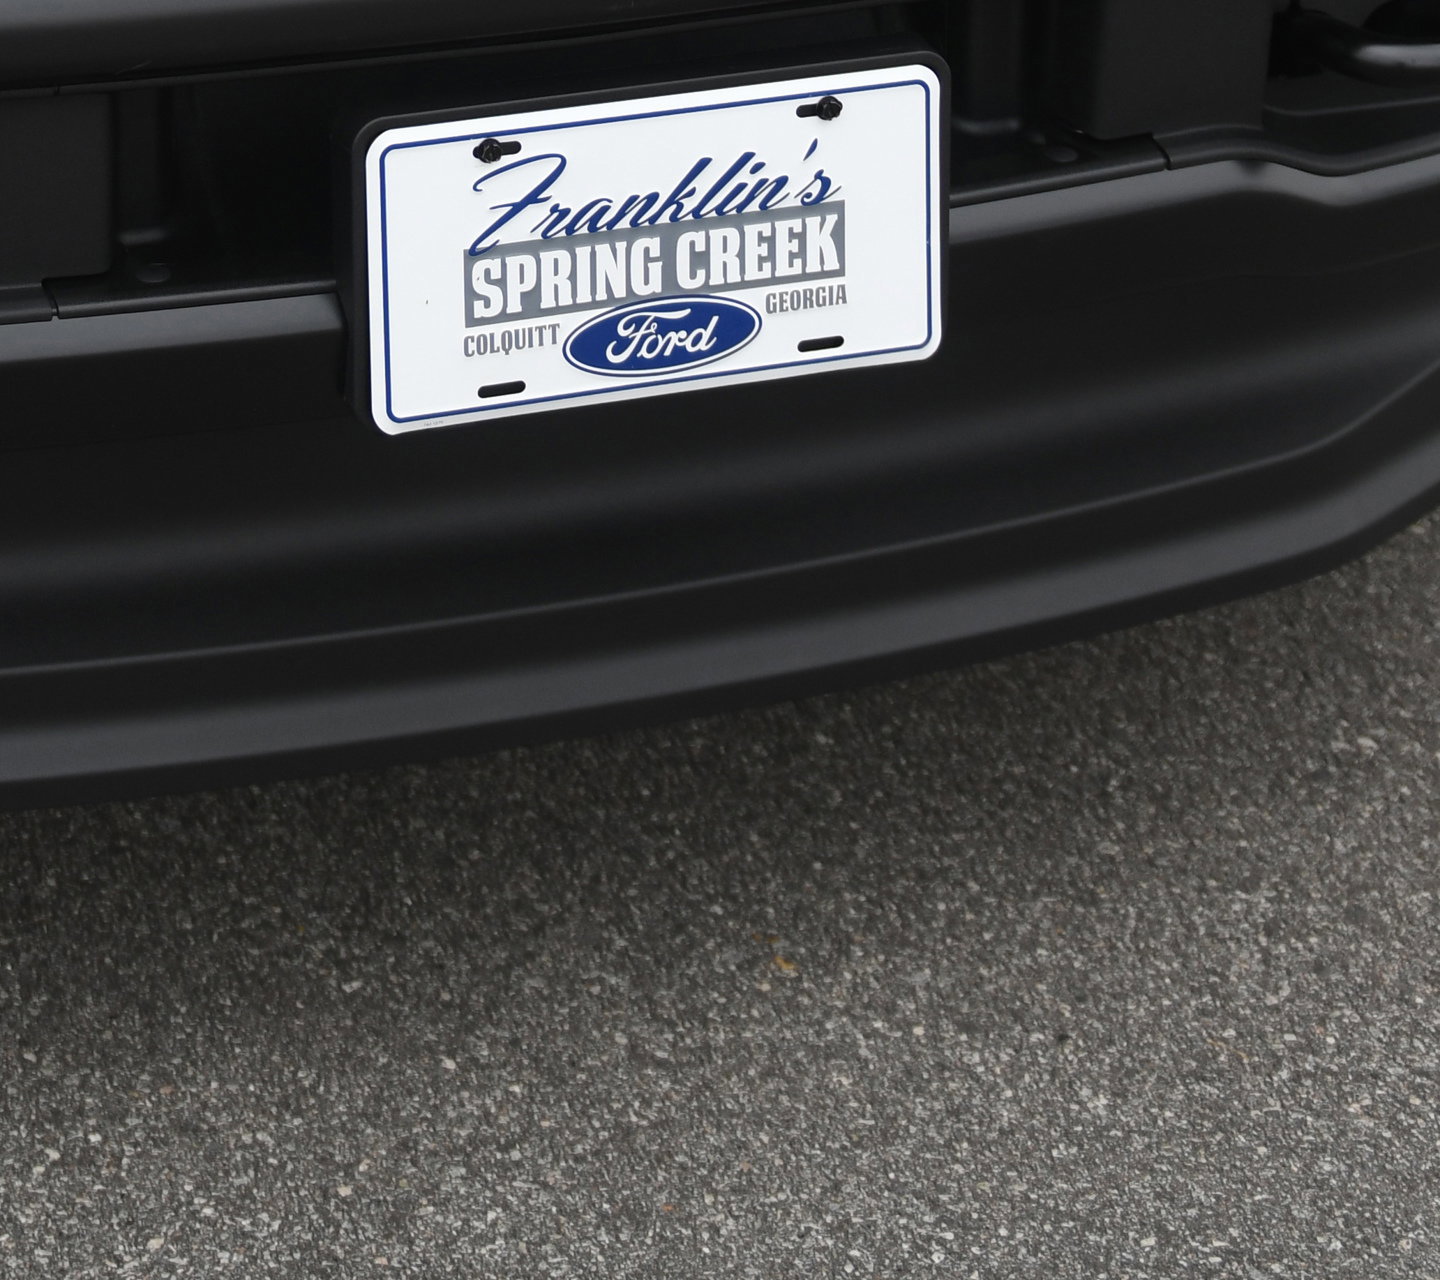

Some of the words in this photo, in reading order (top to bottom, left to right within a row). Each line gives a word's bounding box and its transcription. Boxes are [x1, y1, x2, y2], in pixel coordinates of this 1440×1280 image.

[468, 138, 842, 257] Franklin's
[472, 236, 663, 319] SPRING
[676, 213, 841, 290] CREEK
[765, 283, 848, 315] GEORGIA
[463, 322, 561, 358] COLQUITT
[606, 308, 720, 363] Ford
